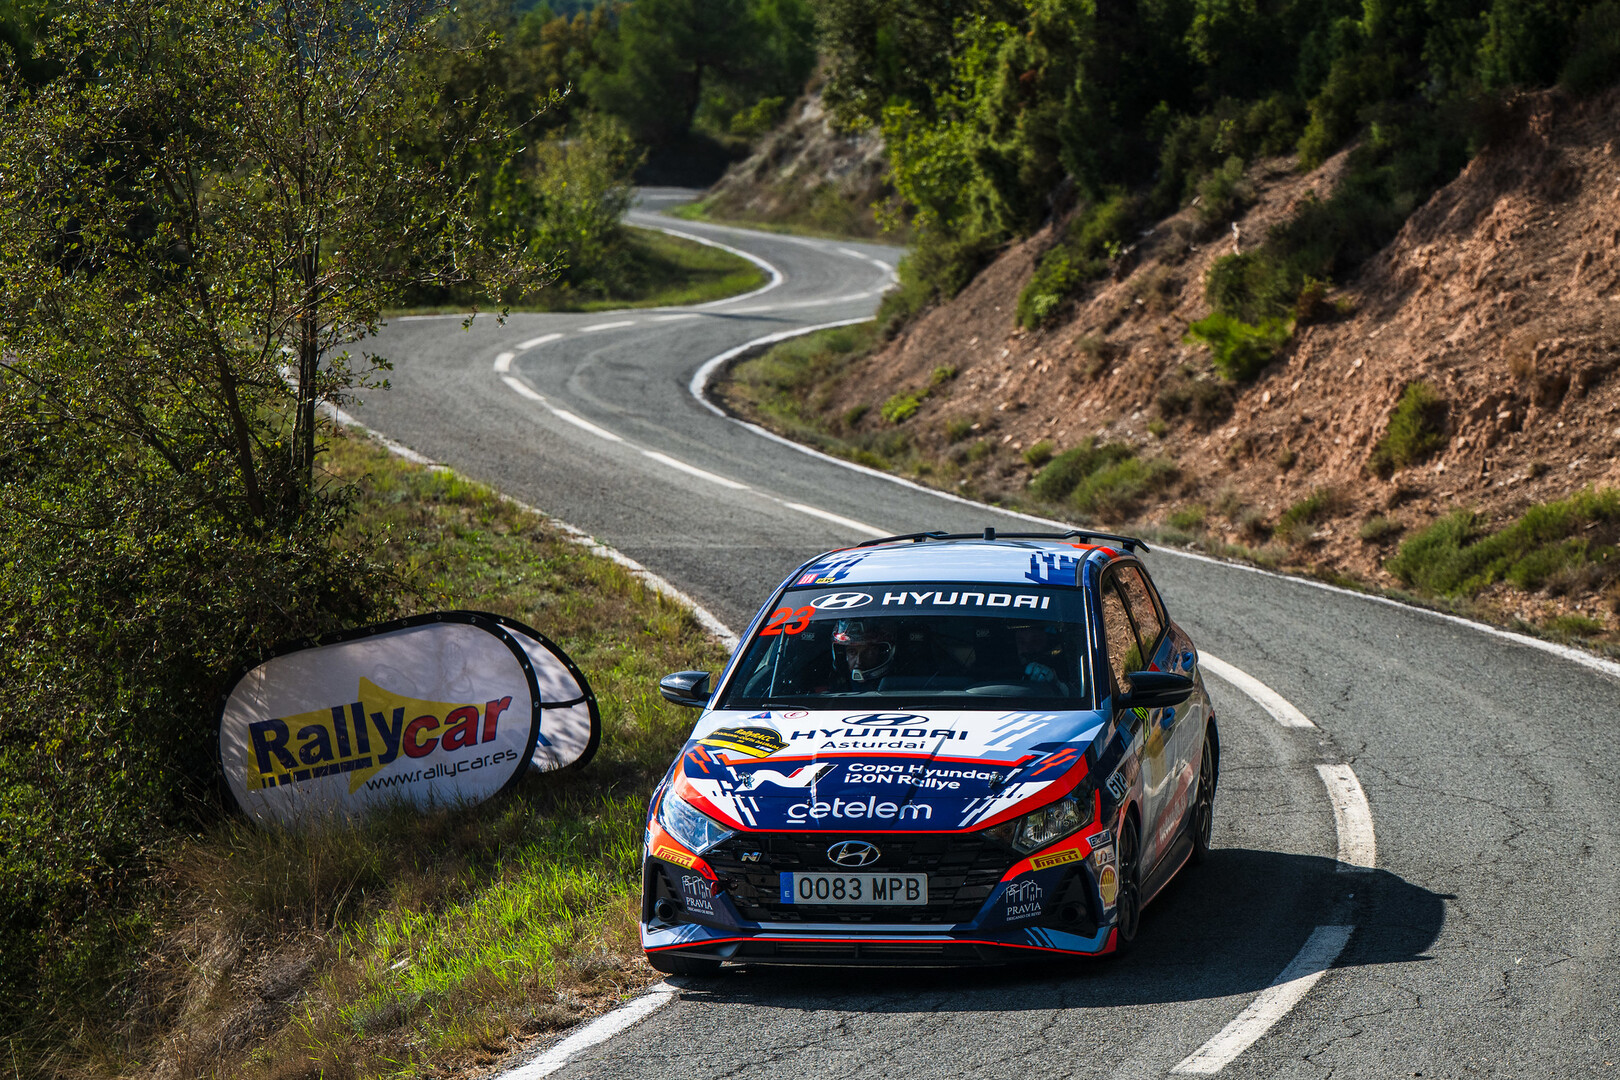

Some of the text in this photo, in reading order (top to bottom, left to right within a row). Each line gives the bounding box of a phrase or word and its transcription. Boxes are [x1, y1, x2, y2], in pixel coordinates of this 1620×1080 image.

[882, 592, 1050, 609] HYUNDAI
[759, 606, 816, 636] 23
[249, 695, 514, 774] Rallycar
[790, 728, 968, 741] HYUNDAI
[820, 740, 926, 750] Asturdai
[365, 749, 518, 791] www.rallycar.es
[848, 763, 995, 781] Copa Hyunda
[844, 773, 961, 790] i20N Rallye
[787, 796, 933, 822] cetelem
[656, 847, 692, 867] PIRELLI
[1033, 850, 1079, 869] PIRELLI
[784, 876, 920, 900] E 0083 MPB
[686, 896, 714, 911] PRAVIA
[1007, 901, 1042, 916] PRAVIA
